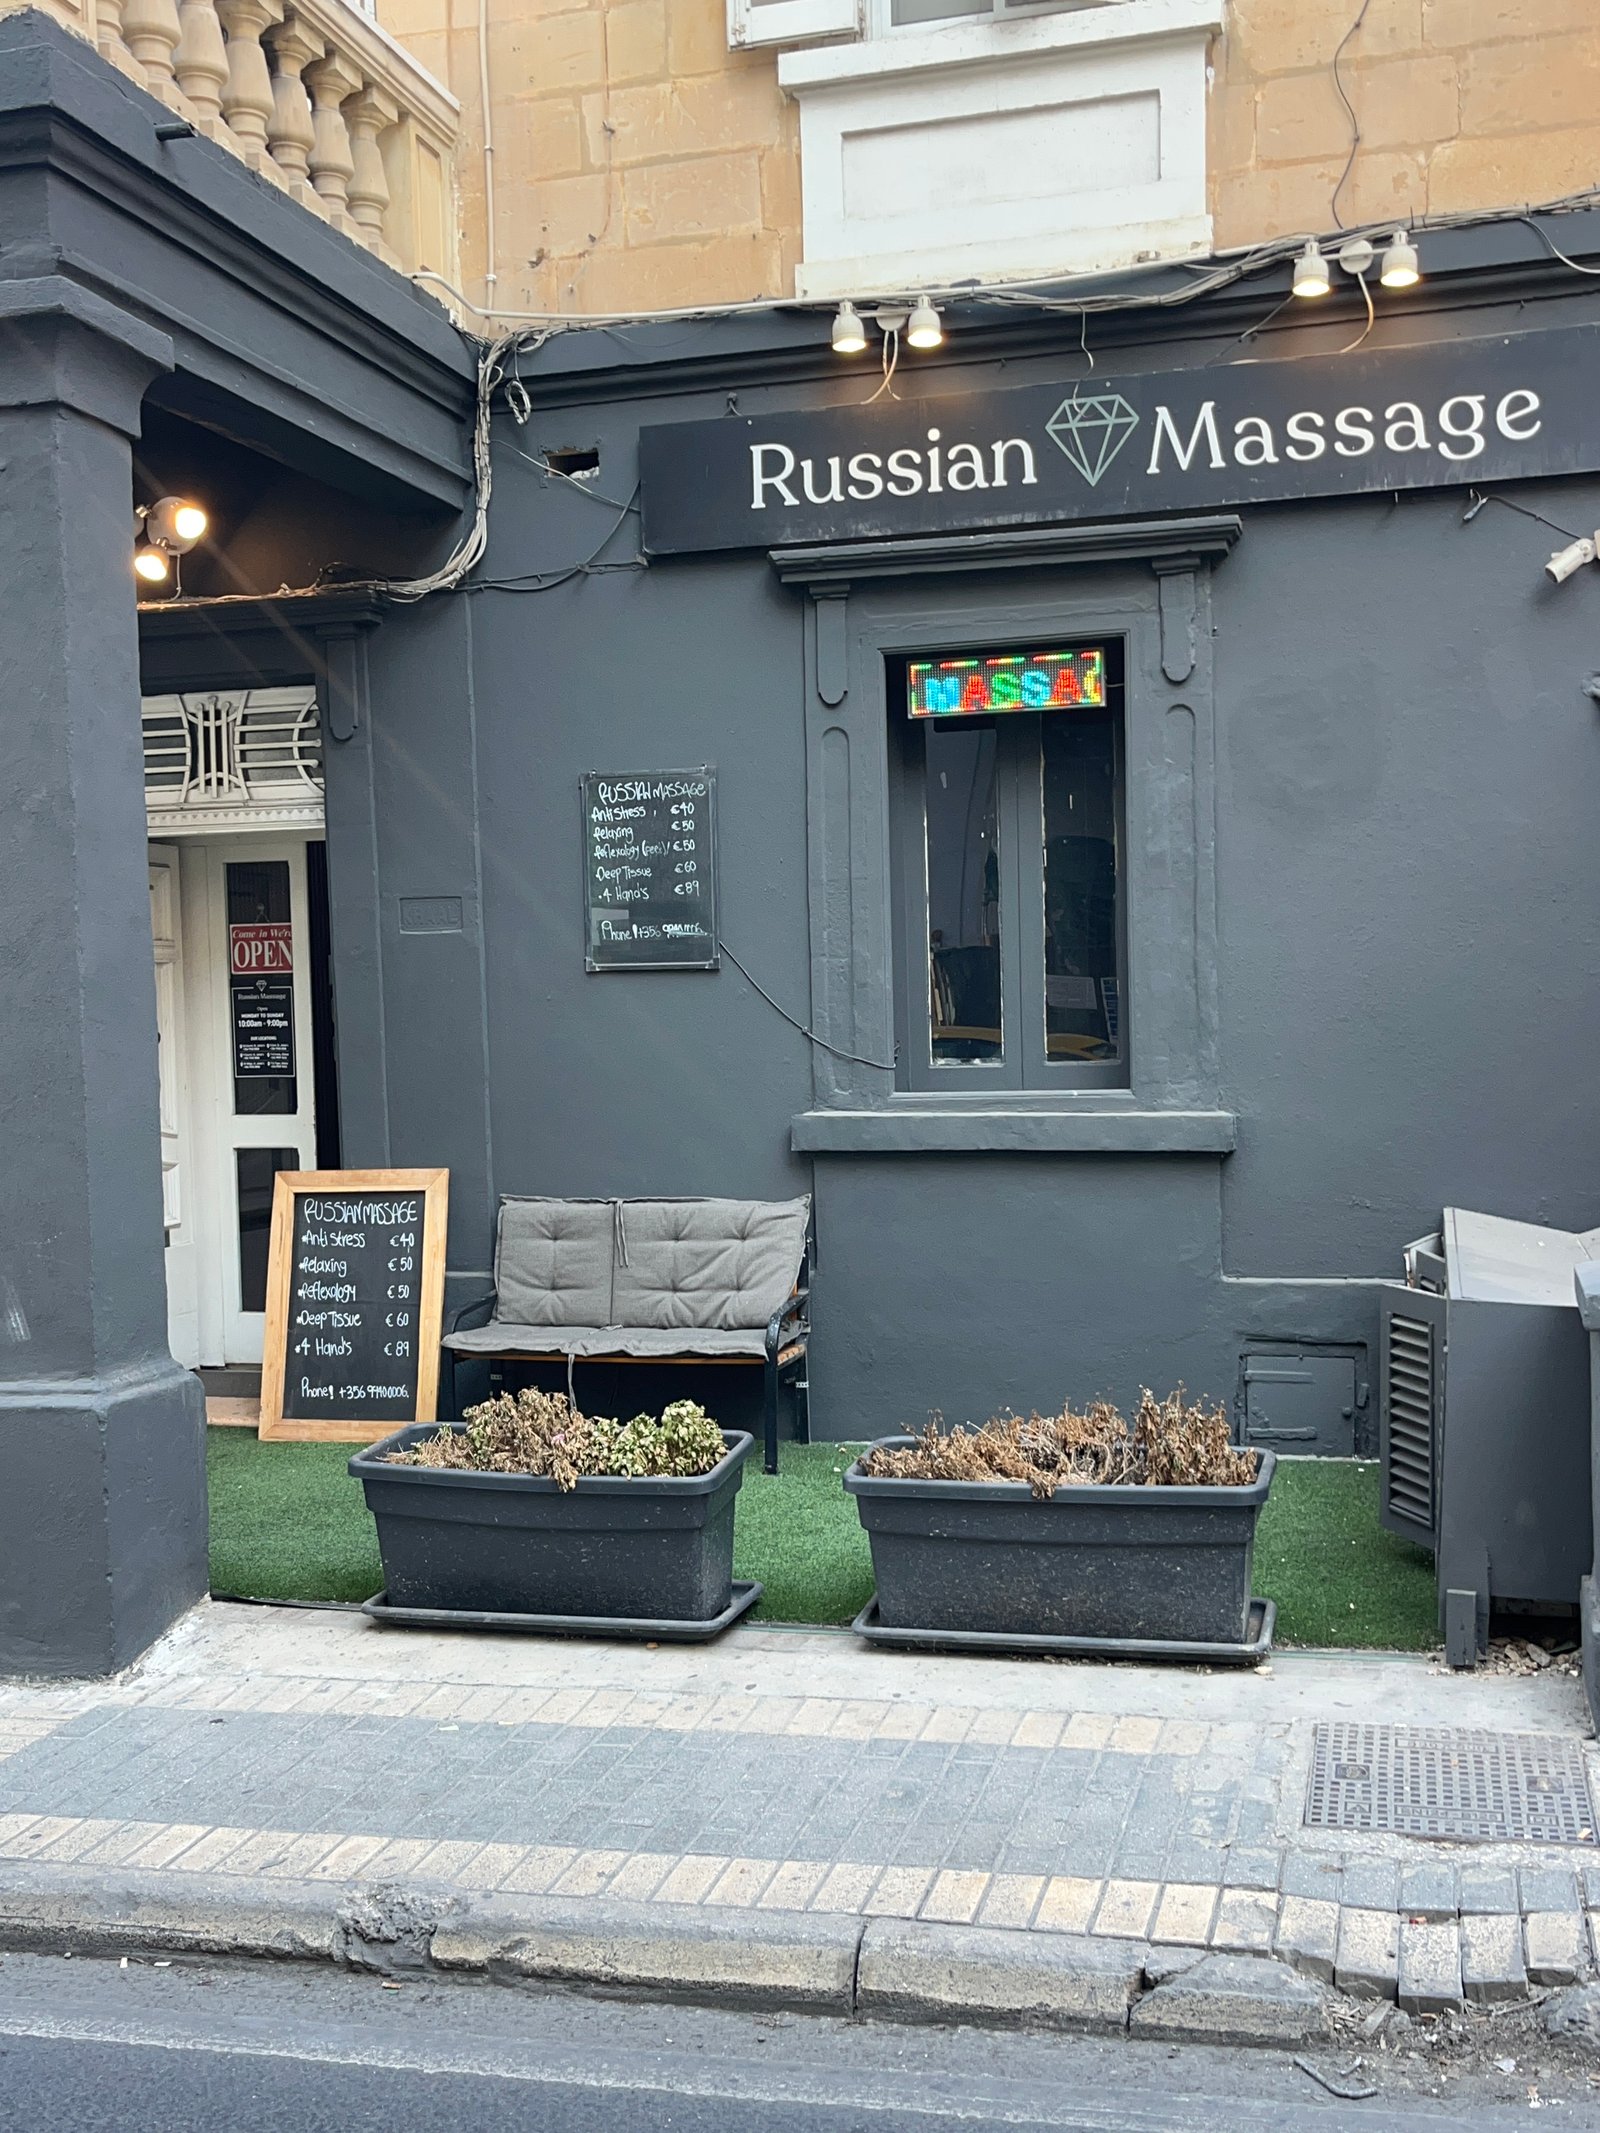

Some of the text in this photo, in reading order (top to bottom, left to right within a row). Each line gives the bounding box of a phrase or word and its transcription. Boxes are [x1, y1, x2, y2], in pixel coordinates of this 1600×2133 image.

[750, 390, 1541, 509] Russian Massage
[232, 930, 256, 938] Come
[259, 929, 268, 938] in
[234, 940, 292, 968] OPEN
[305, 1228, 328, 1247] Anti
[300, 1310, 327, 1330] Deep
[327, 1311, 362, 1328] Tissue
[300, 1337, 311, 1356] 4
